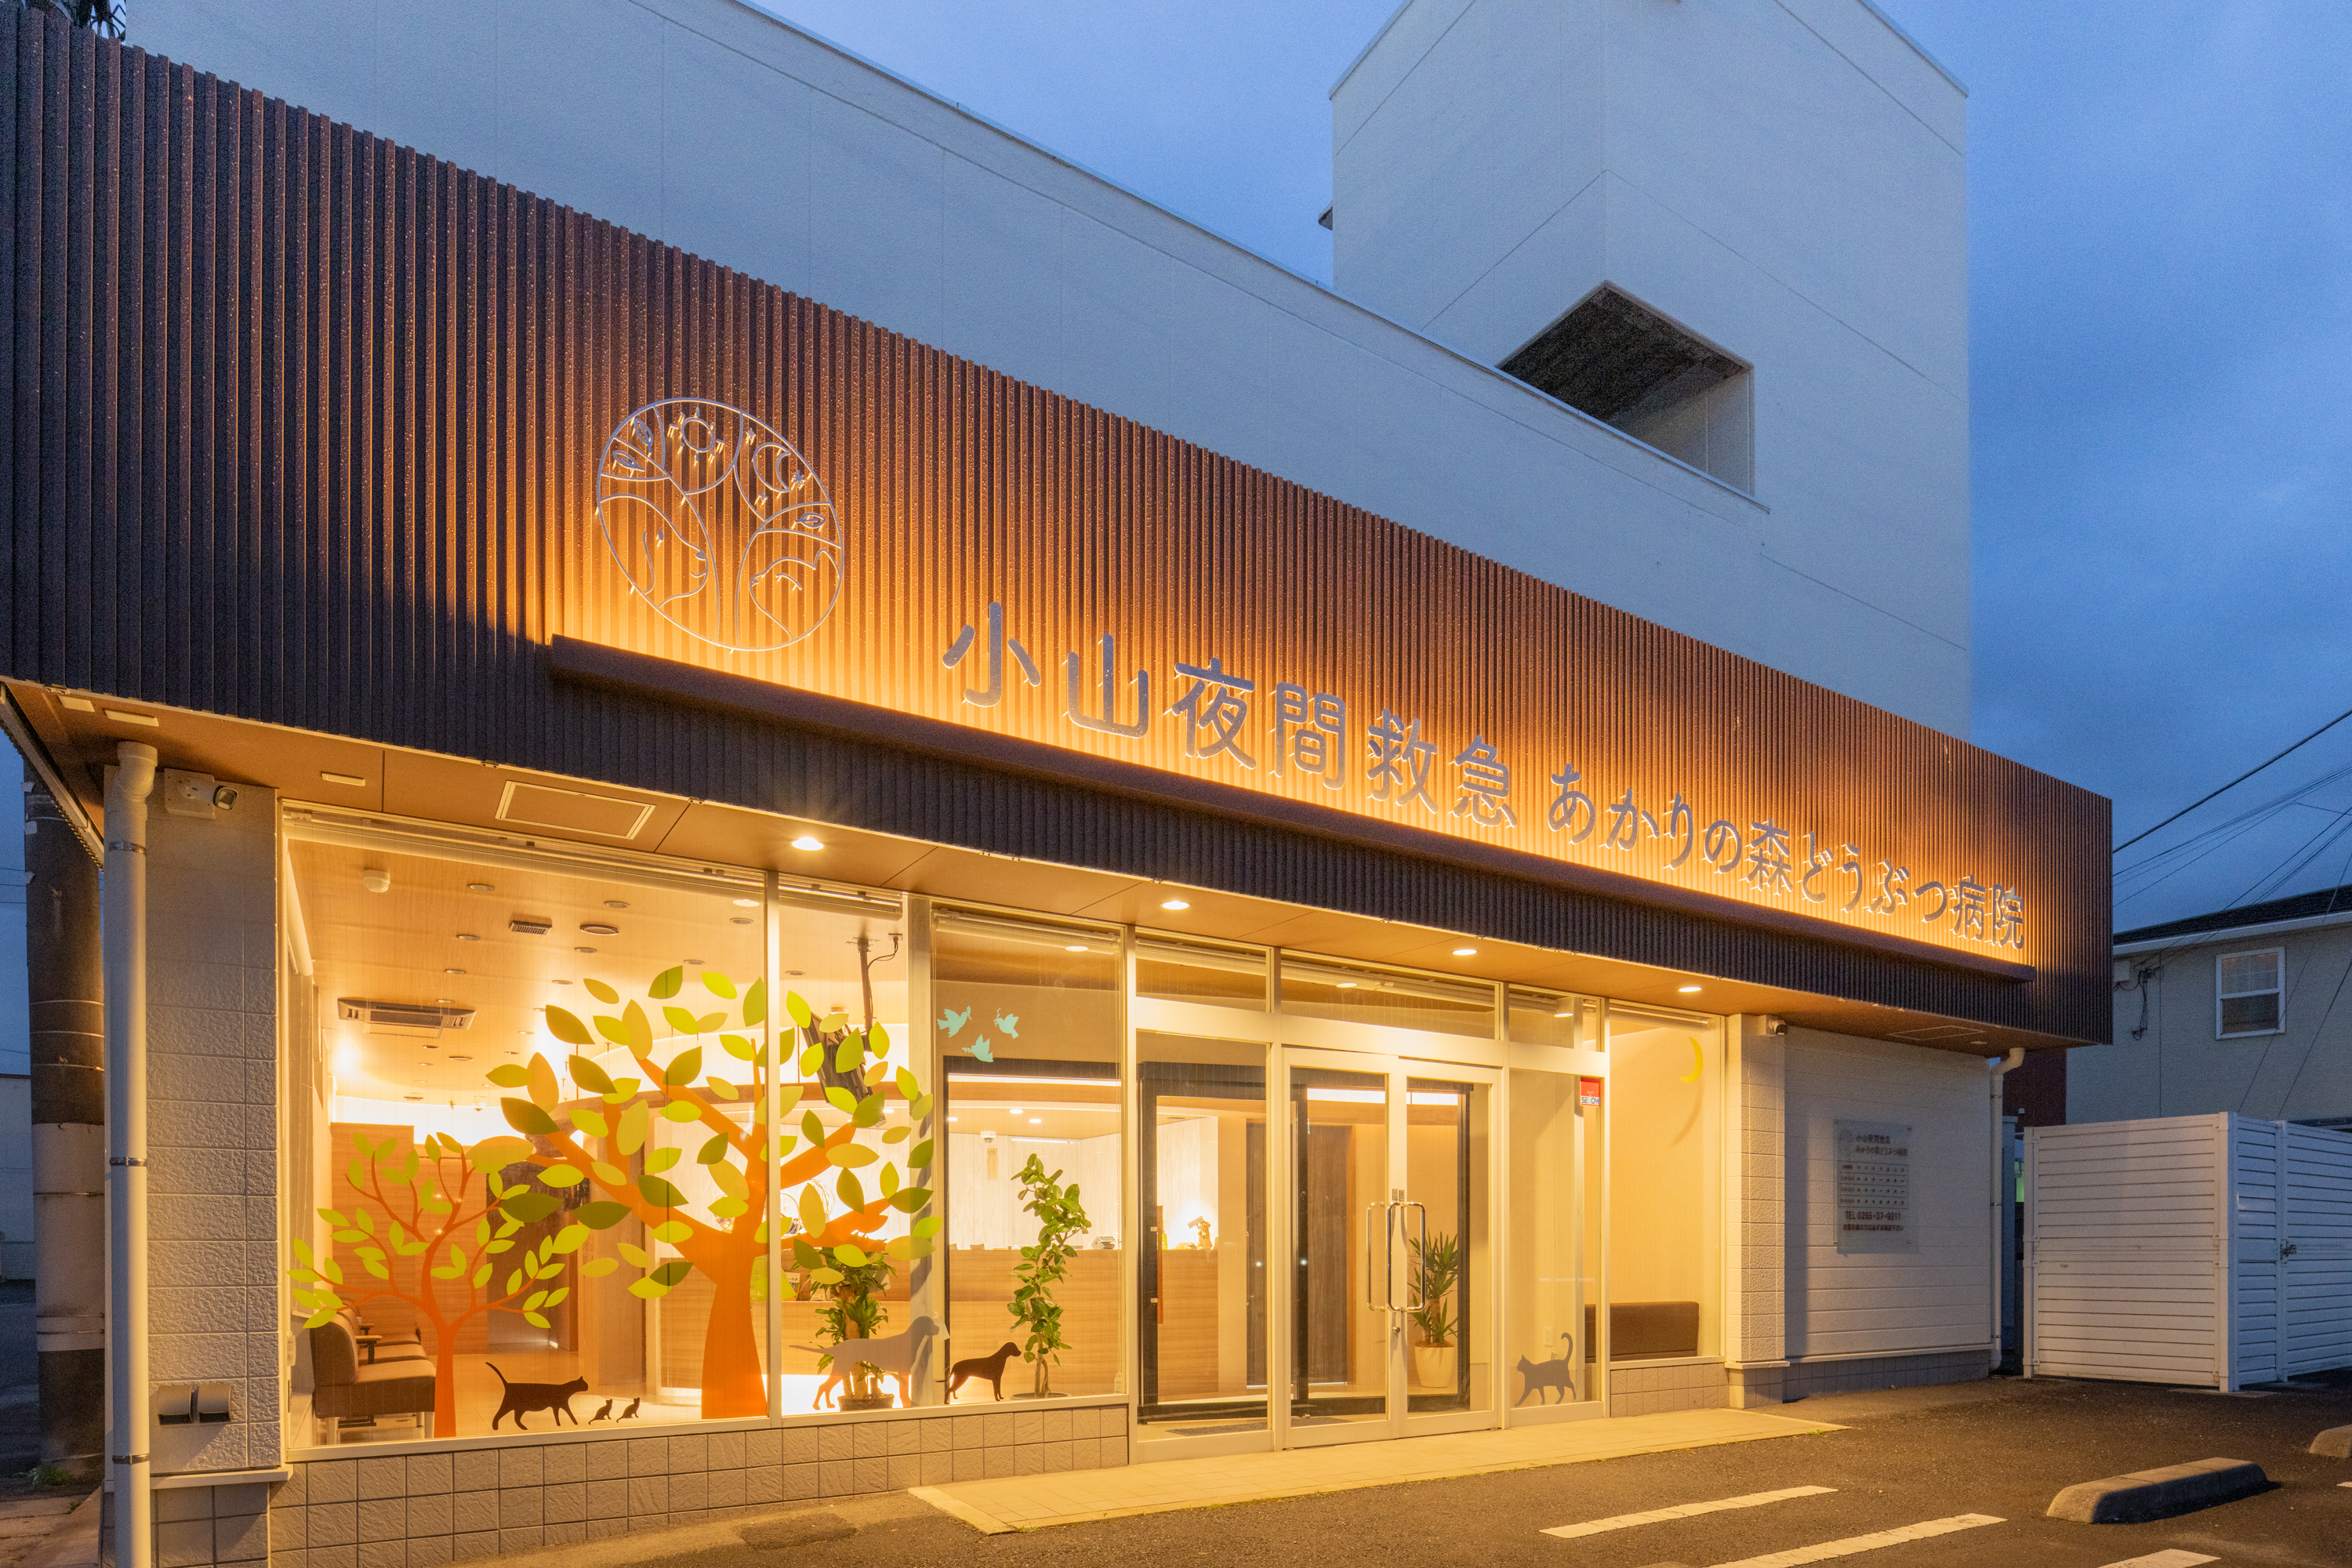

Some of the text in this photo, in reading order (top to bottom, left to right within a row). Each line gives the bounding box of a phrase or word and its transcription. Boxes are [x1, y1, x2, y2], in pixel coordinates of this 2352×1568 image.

[942, 601, 2026, 950] 小山夜間救急 あかりの森どうぶつ病院
[1581, 1096, 1599, 1105] SECOM
[1845, 1210, 1901, 1221] TEL 0285-37-9211
